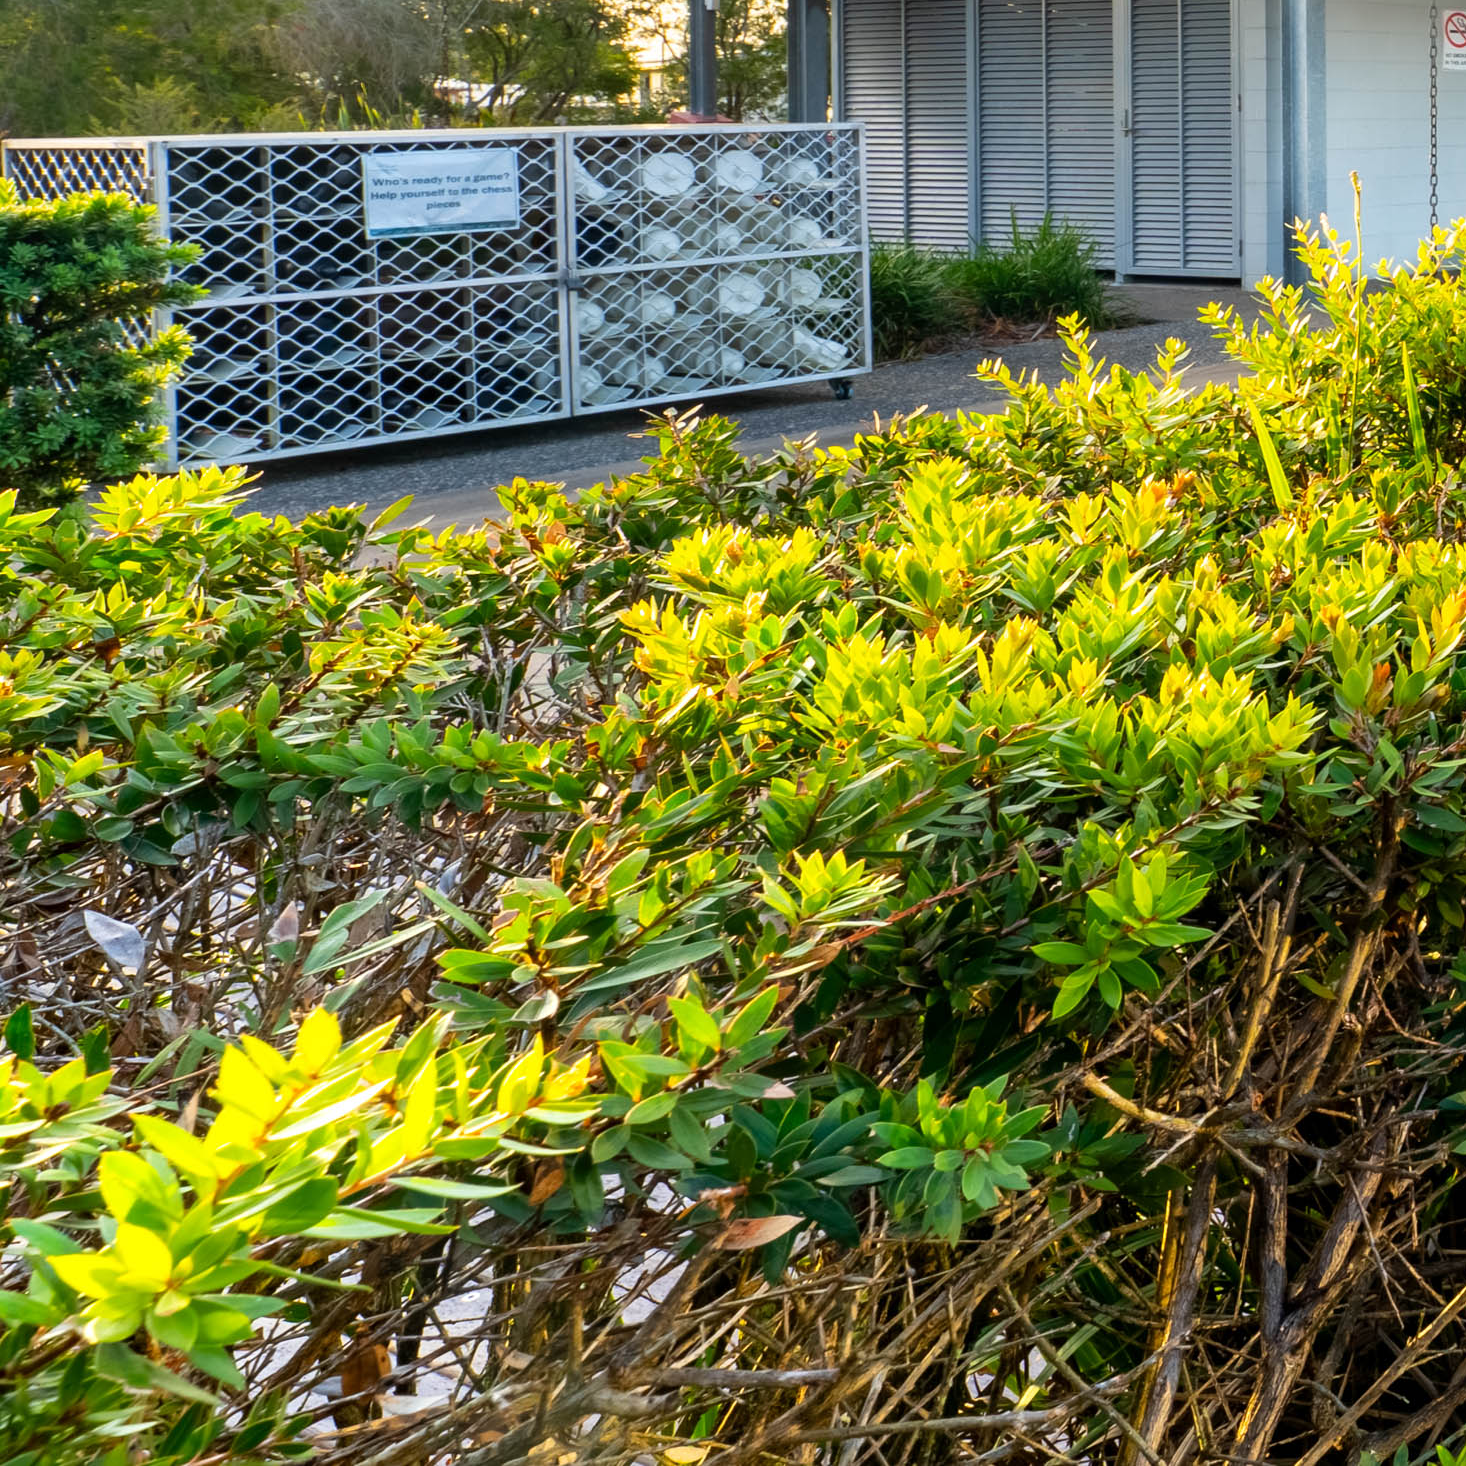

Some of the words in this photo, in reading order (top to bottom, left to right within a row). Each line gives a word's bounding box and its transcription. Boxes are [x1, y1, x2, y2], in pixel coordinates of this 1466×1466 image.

[372, 177, 409, 187] Who's
[412, 176, 443, 186] ready
[446, 175, 462, 184] for
[464, 175, 471, 183] a
[473, 172, 510, 184] game?
[370, 191, 397, 201] Help
[400, 188, 446, 200] yourself
[461, 186, 478, 195] the
[481, 185, 513, 194] chess
[426, 200, 462, 211] pieces
